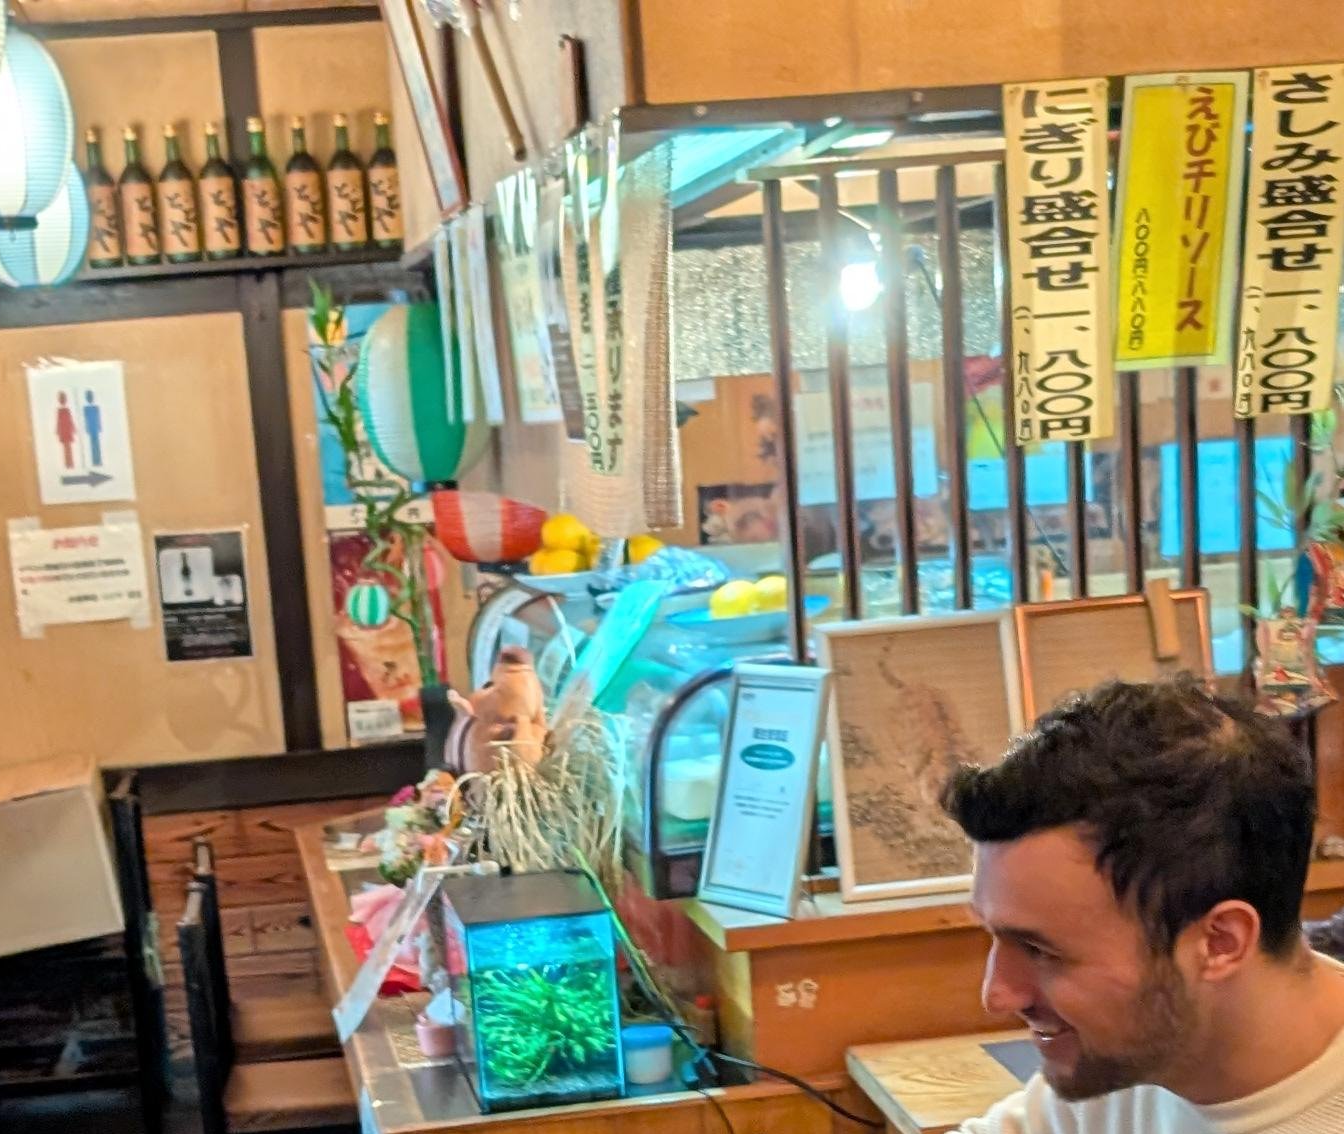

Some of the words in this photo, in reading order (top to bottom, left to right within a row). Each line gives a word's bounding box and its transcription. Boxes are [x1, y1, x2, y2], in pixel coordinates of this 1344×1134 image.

[1175, 86, 1221, 333] えびチリソース
